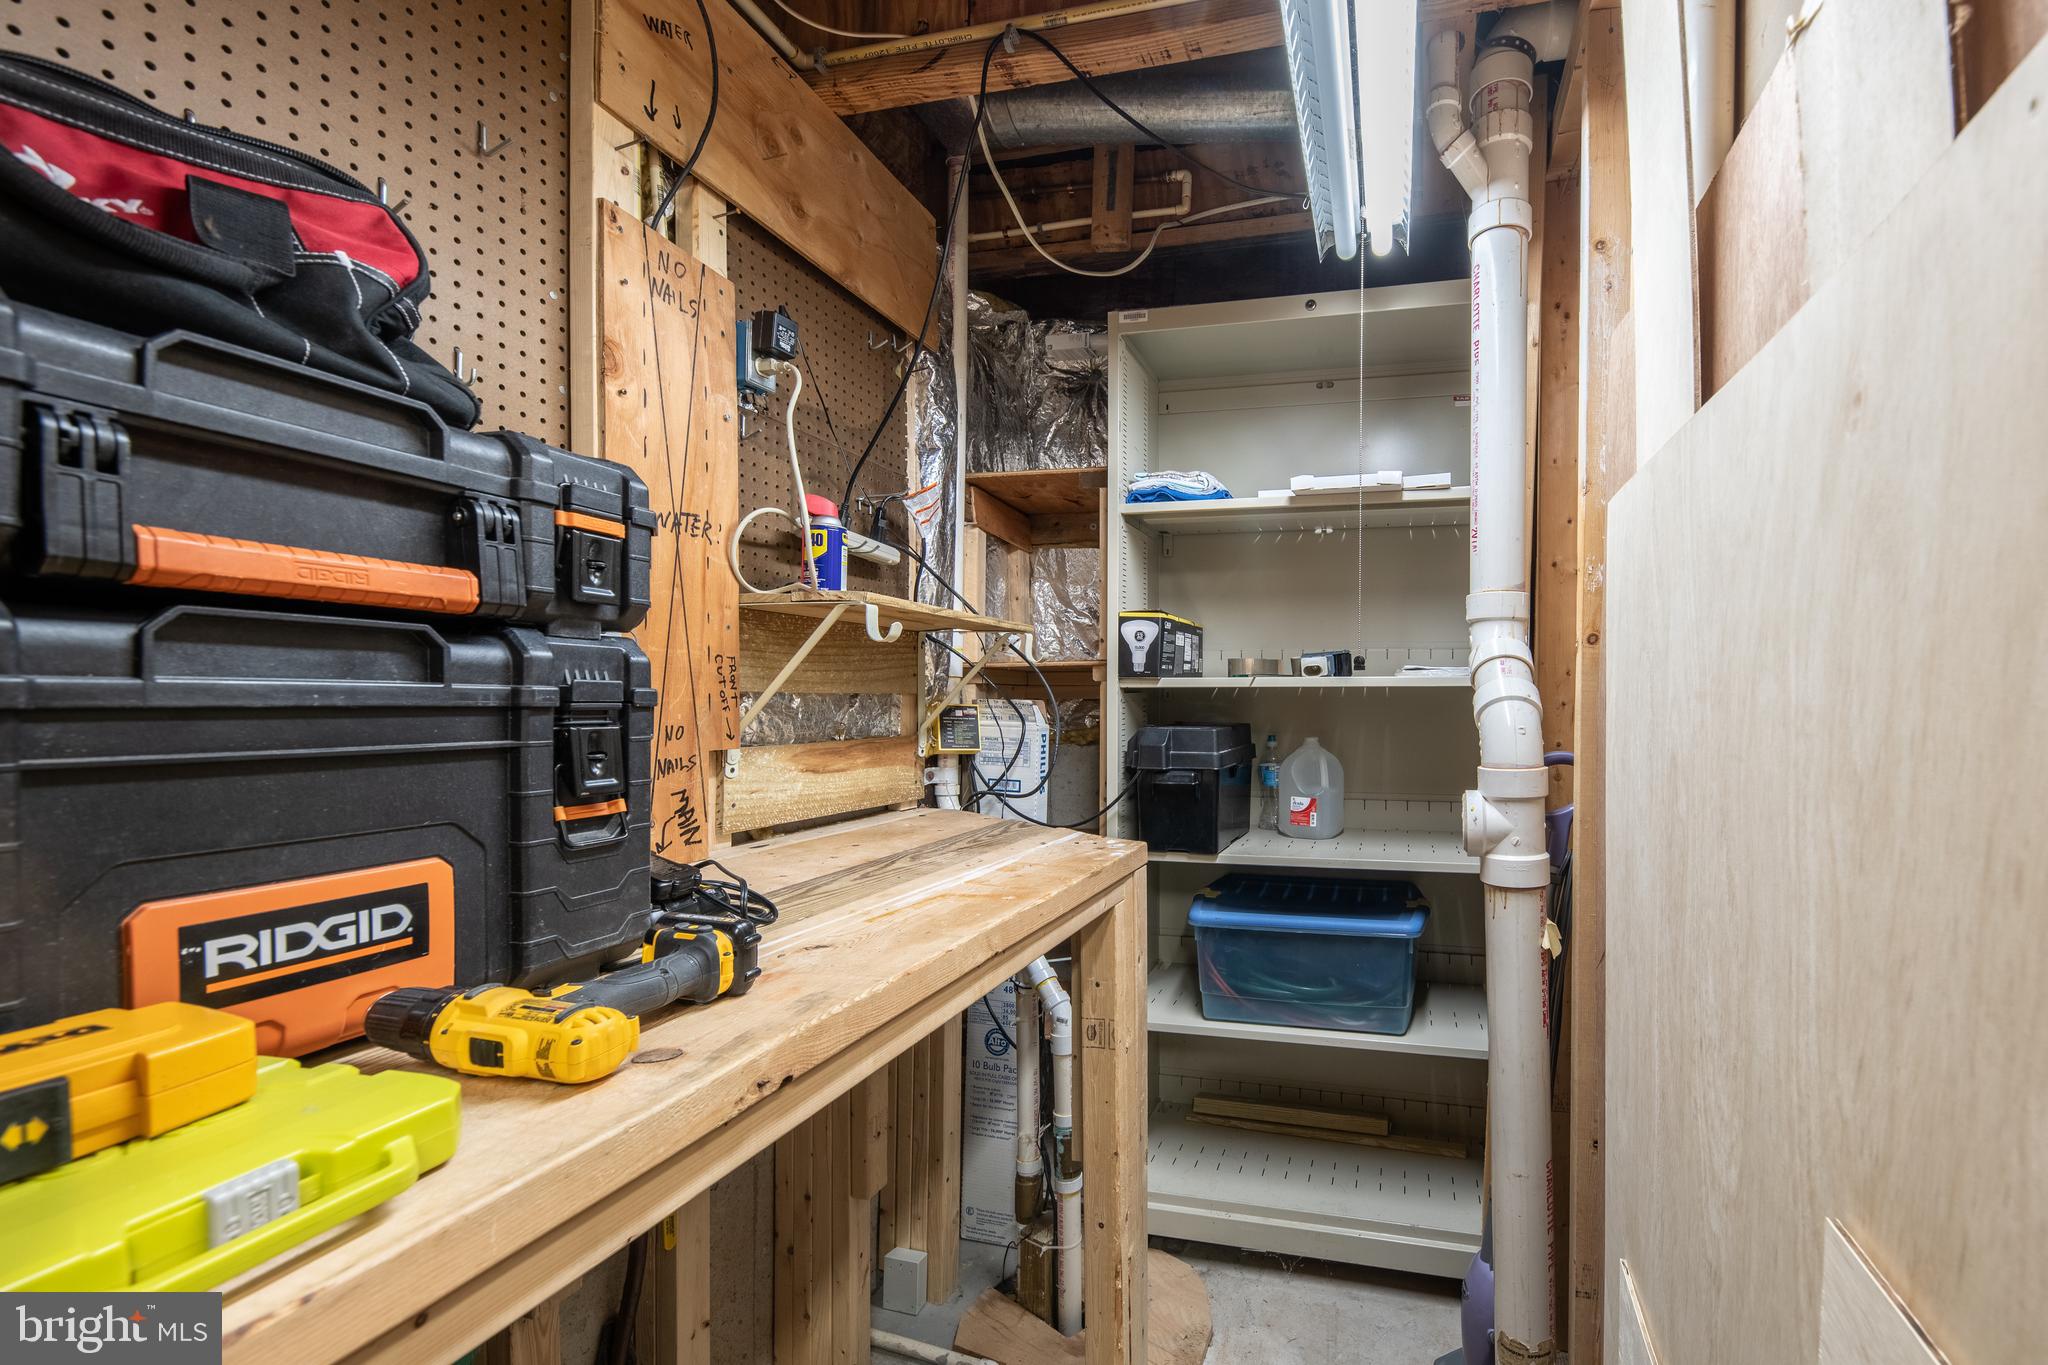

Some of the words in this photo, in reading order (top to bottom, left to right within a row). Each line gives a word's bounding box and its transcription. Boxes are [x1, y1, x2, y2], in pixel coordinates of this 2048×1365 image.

[642, 13, 693, 51] WATER
[658, 250, 687, 279] NO
[651, 276, 698, 318] NAILS
[1472, 264, 1480, 333] CHARLOTTE
[714, 654, 726, 689] CUT
[726, 655, 739, 707] FRONT
[719, 689, 731, 712] OFF
[665, 725, 685, 746] NO
[657, 754, 697, 780] NAILS
[671, 788, 702, 846] MAIN
[203, 903, 414, 979] RIDGID
[972, 1060, 980, 1069] 10
[983, 1061, 1001, 1072] Bulb
[1003, 1064, 1017, 1074] Pac
